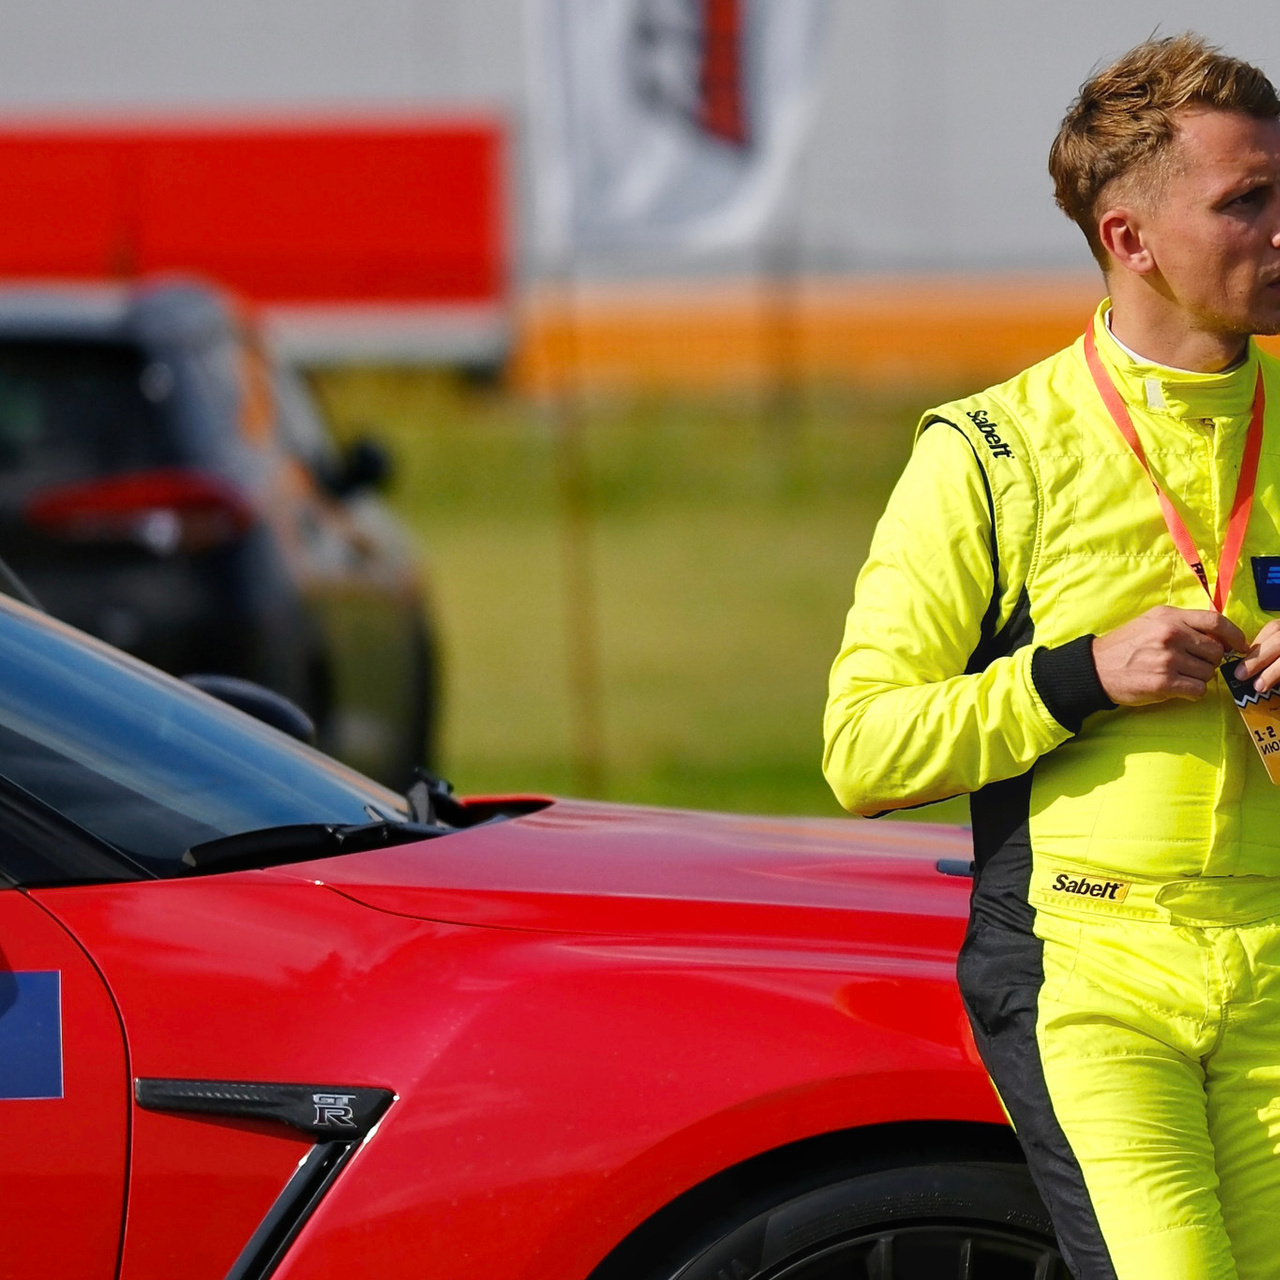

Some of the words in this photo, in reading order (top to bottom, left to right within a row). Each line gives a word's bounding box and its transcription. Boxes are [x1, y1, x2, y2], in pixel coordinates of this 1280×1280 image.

[966, 410, 1014, 459] Sabelt
[1254, 725, 1277, 742] 1-2
[1052, 874, 1119, 900] Sabelt
